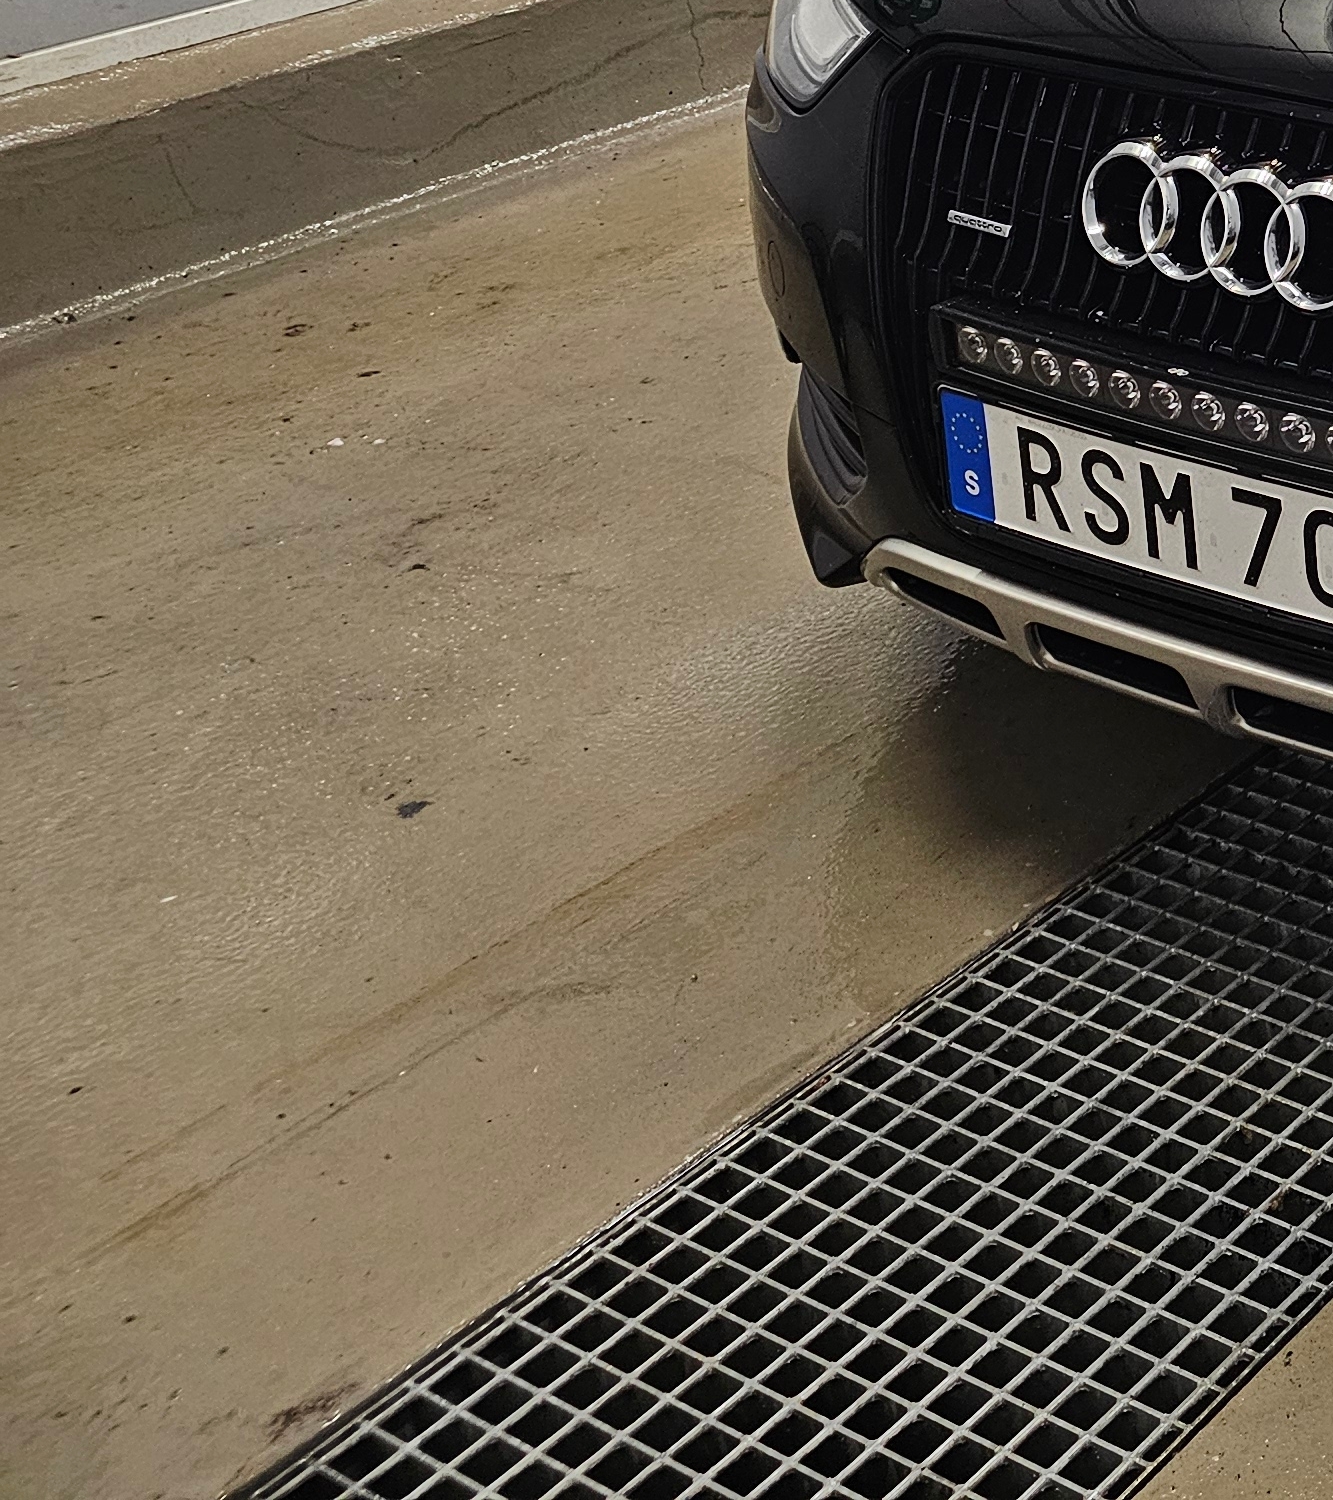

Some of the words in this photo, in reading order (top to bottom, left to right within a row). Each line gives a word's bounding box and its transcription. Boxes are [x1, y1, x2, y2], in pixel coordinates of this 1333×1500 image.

[953, 213, 1003, 233] quattro
[964, 469, 980, 496] S
[1016, 425, 1199, 571] RSM
